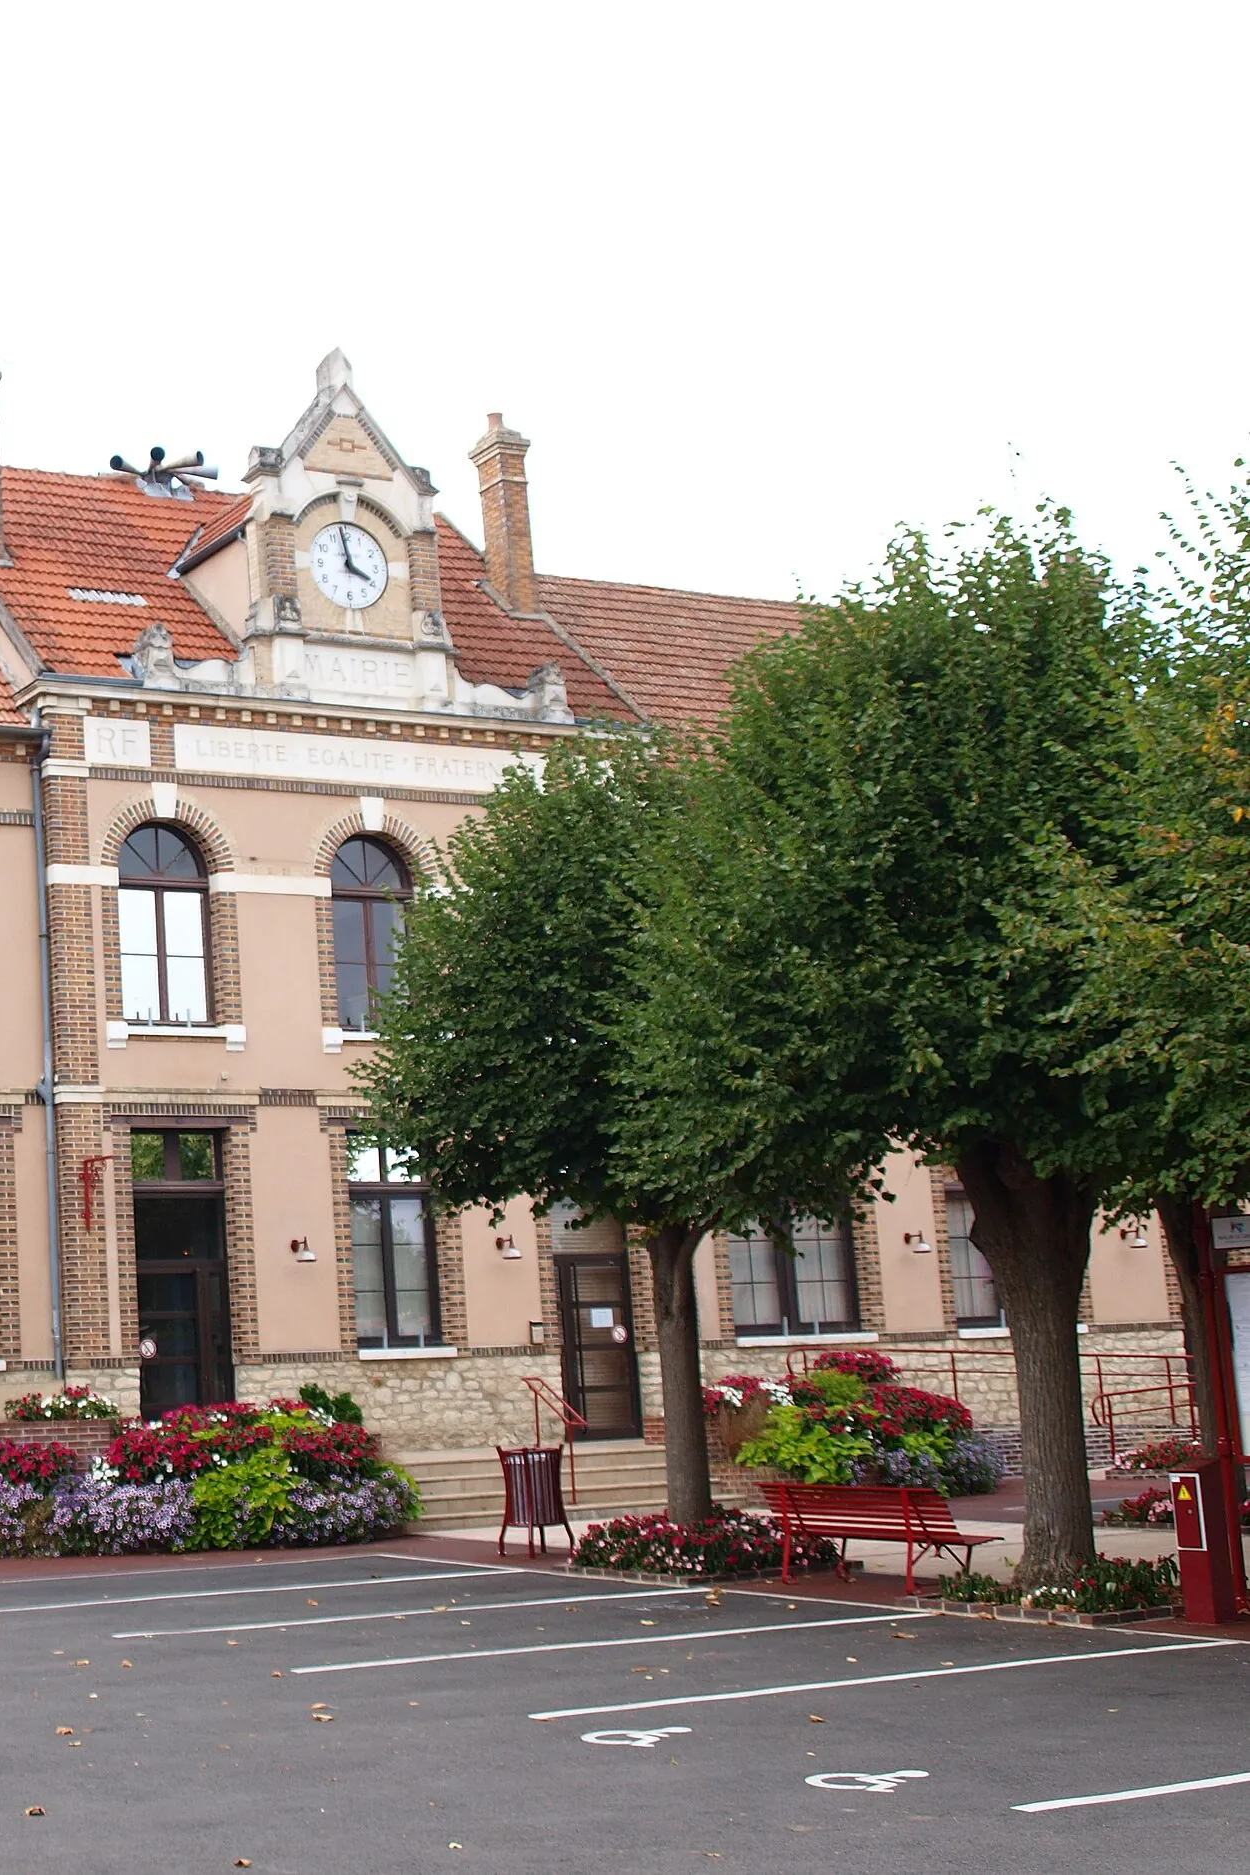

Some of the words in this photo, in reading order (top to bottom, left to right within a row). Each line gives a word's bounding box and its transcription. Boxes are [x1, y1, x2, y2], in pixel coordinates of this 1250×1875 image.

[330, 534, 336, 543] 11
[319, 544, 328, 552] 10
[368, 549, 374, 558] 2
[317, 558, 324, 567] 9
[373, 565, 379, 574] 3
[322, 574, 329, 583] 8
[333, 585, 338, 594] 7
[361, 588, 367, 598] 5
[347, 591, 353, 600] 6
[304, 653, 414, 688] MAIRIE
[96, 727, 138, 758] RF
[196, 739, 287, 762] LIBERTE
[308, 748, 396, 771] EGALITE
[415, 757, 502, 781] FRATERN
